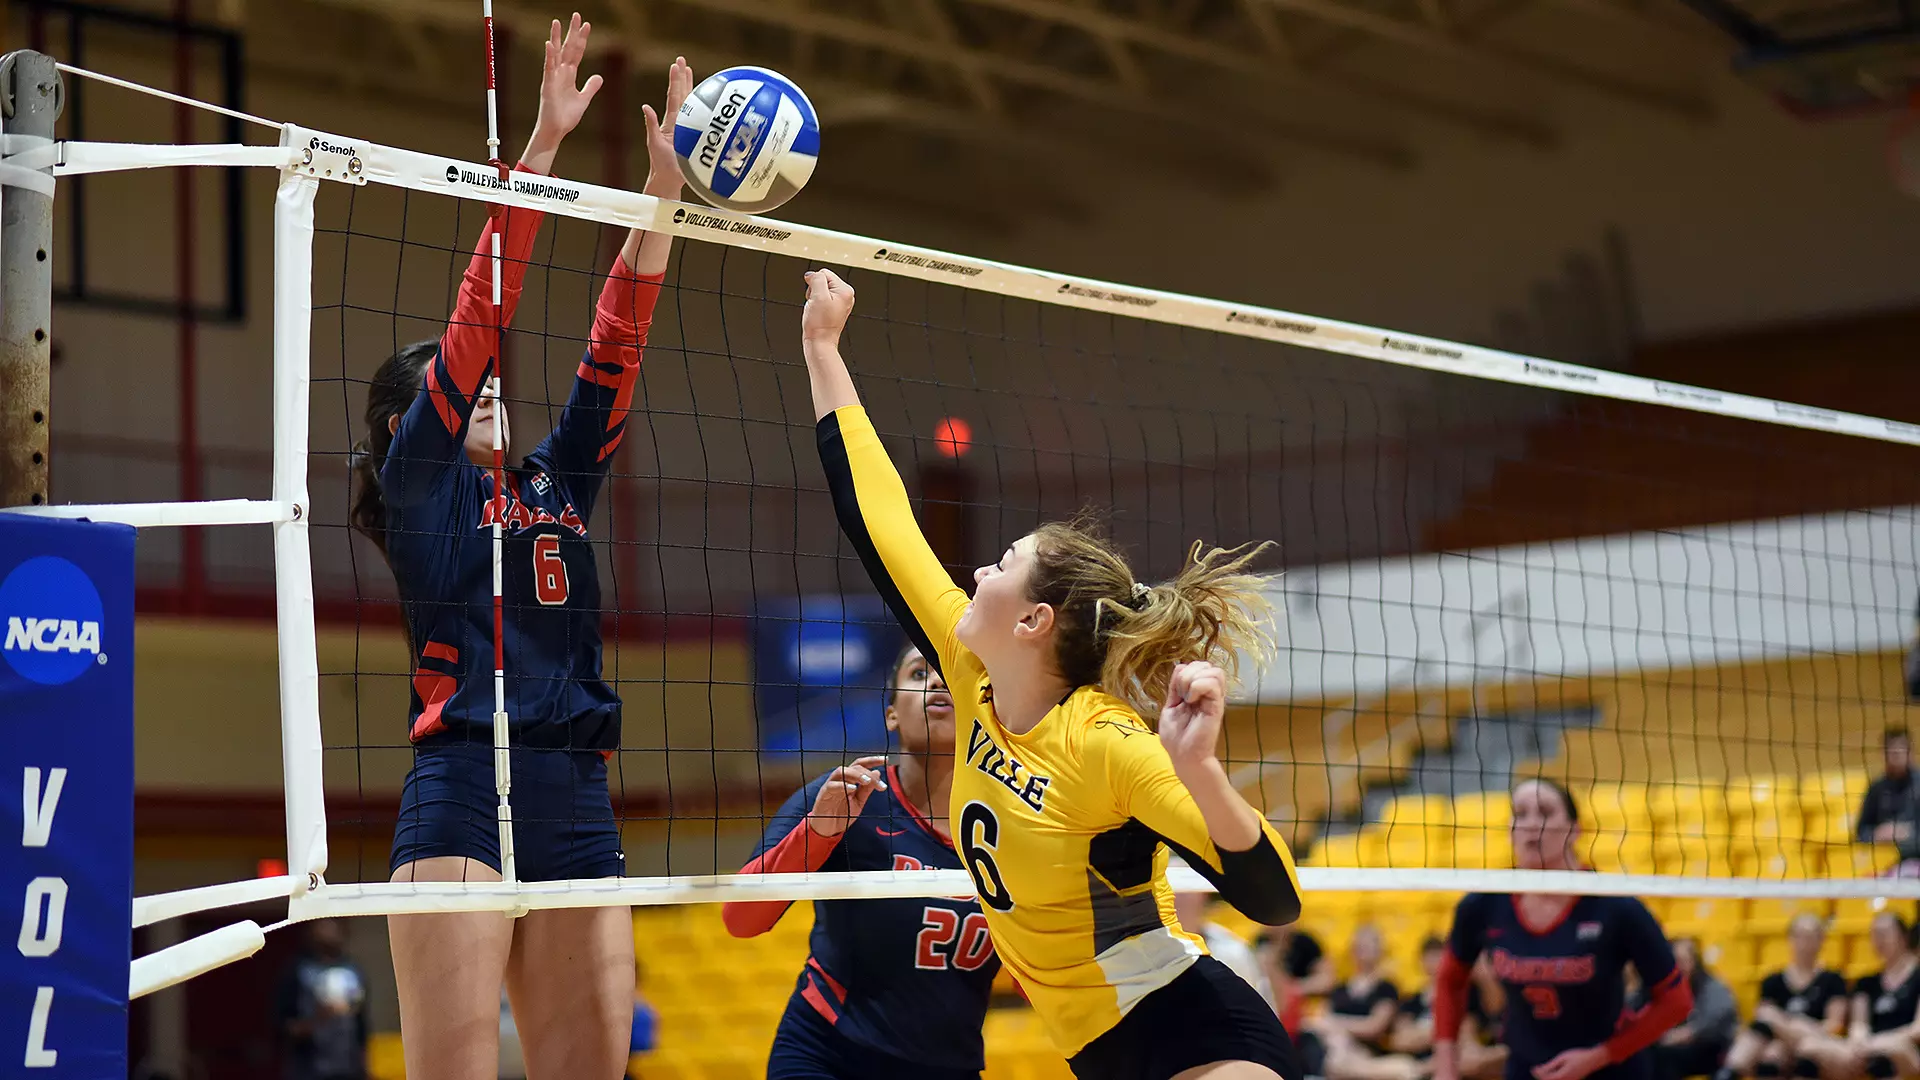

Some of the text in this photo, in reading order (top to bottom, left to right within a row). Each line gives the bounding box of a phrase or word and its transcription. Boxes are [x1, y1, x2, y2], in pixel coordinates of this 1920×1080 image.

[320, 141, 355, 157] Senoh
[700, 92, 746, 168] molten
[720, 107, 767, 177] NCAA
[514, 180, 580, 203] CHAMPIONSHIP
[684, 212, 792, 242] VOLLEYBALL CHAMPIONSHIP
[885, 251, 984, 277] VOLLEYBALL CHAMPIONSHIP
[533, 533, 570, 606] 6
[4, 616, 101, 655] NCAA
[966, 717, 1051, 814] VILLE
[961, 799, 1016, 913] 6
[915, 906, 995, 972] 20
